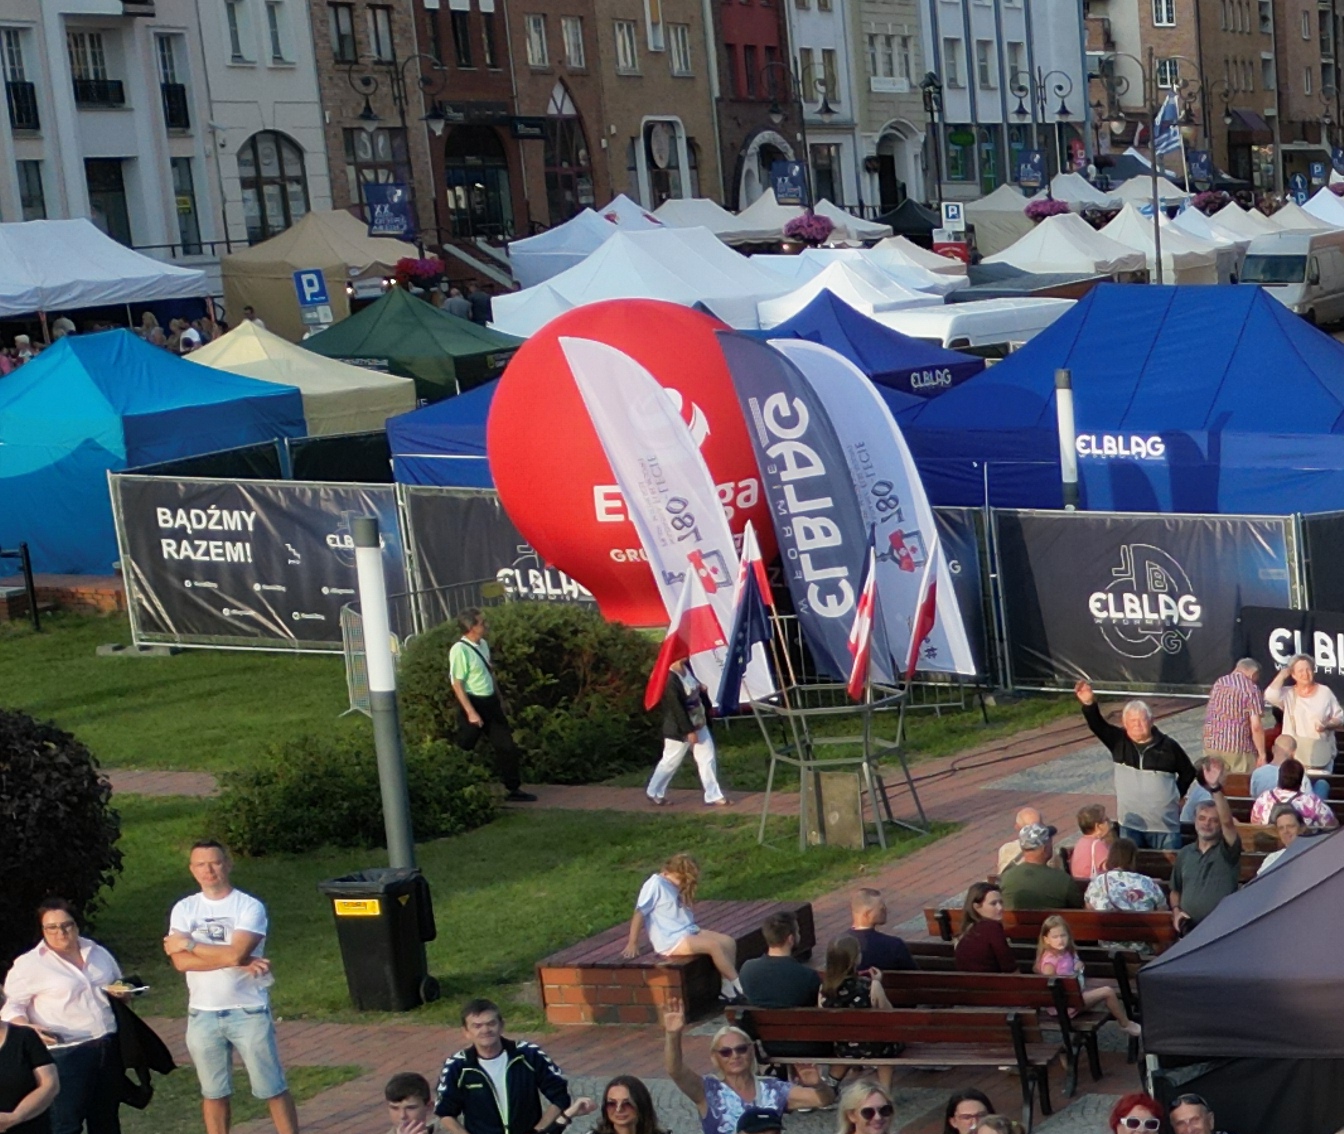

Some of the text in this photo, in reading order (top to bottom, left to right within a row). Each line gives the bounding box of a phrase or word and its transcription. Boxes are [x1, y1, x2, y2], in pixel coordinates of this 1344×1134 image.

[302, 273, 320, 302] P
[156, 504, 257, 534] BĄDŹMY
[161, 538, 254, 563] RAZEM!
